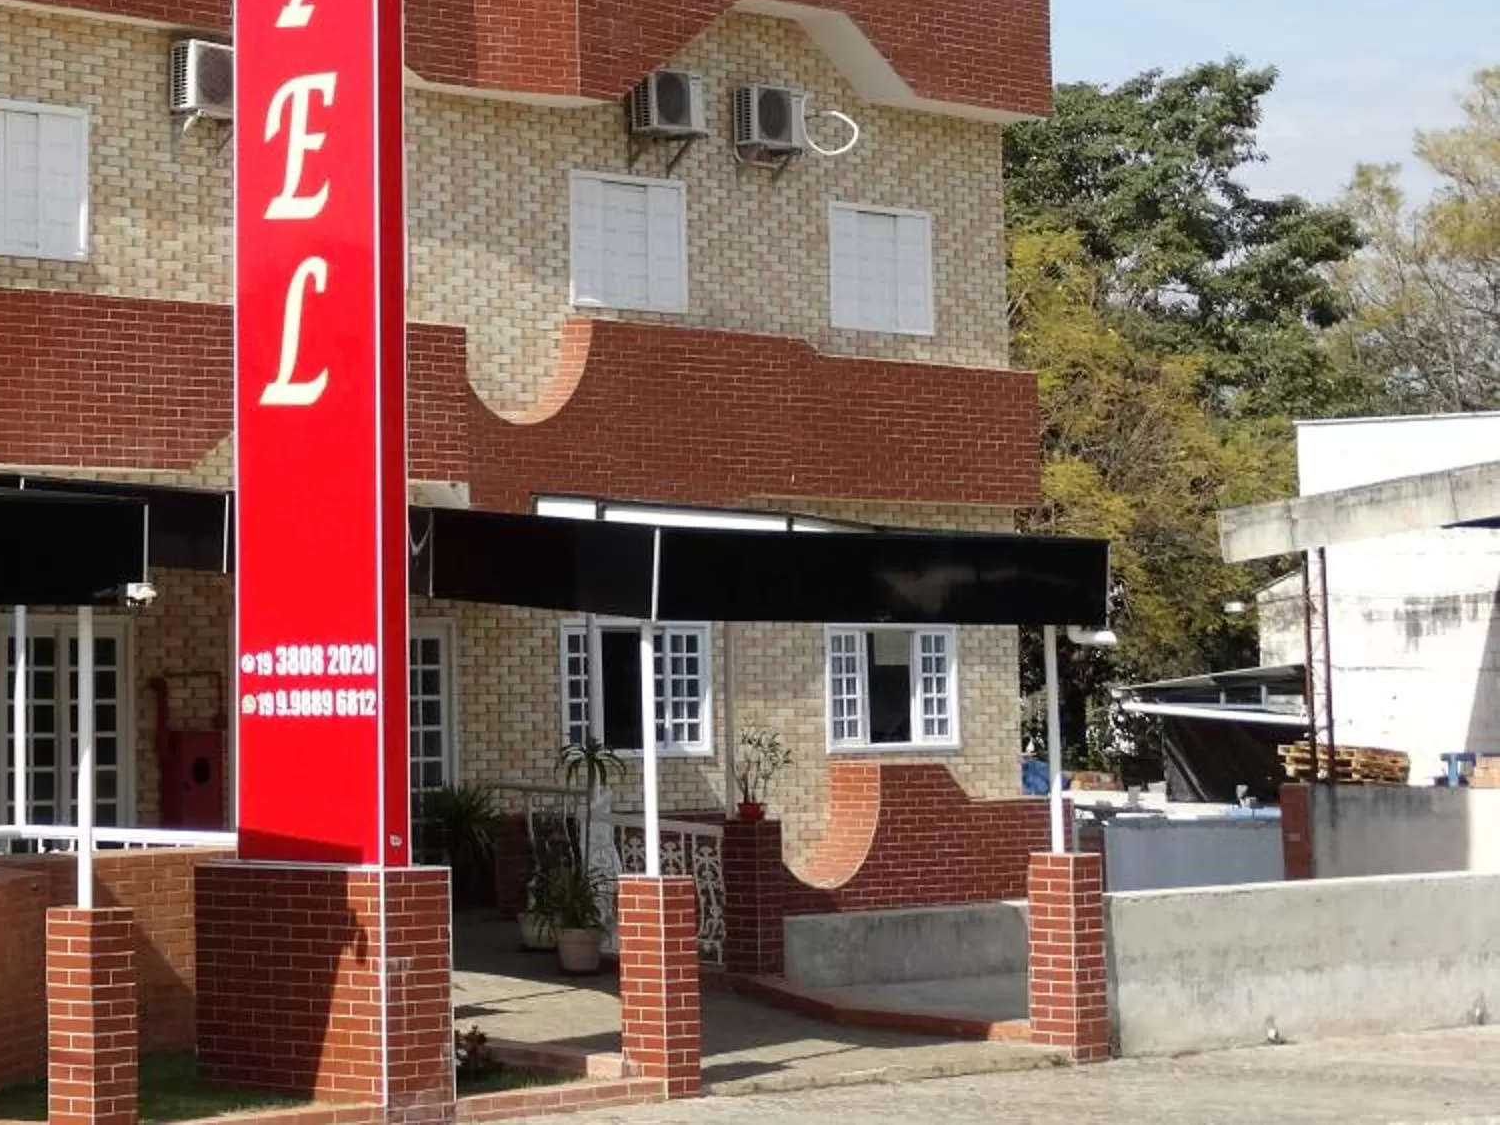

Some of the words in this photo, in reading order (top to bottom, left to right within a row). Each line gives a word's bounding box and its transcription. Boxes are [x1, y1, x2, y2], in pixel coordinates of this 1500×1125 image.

[256, 651, 273, 676] 19
[275, 645, 325, 676] 3808
[327, 643, 376, 675] 2020
